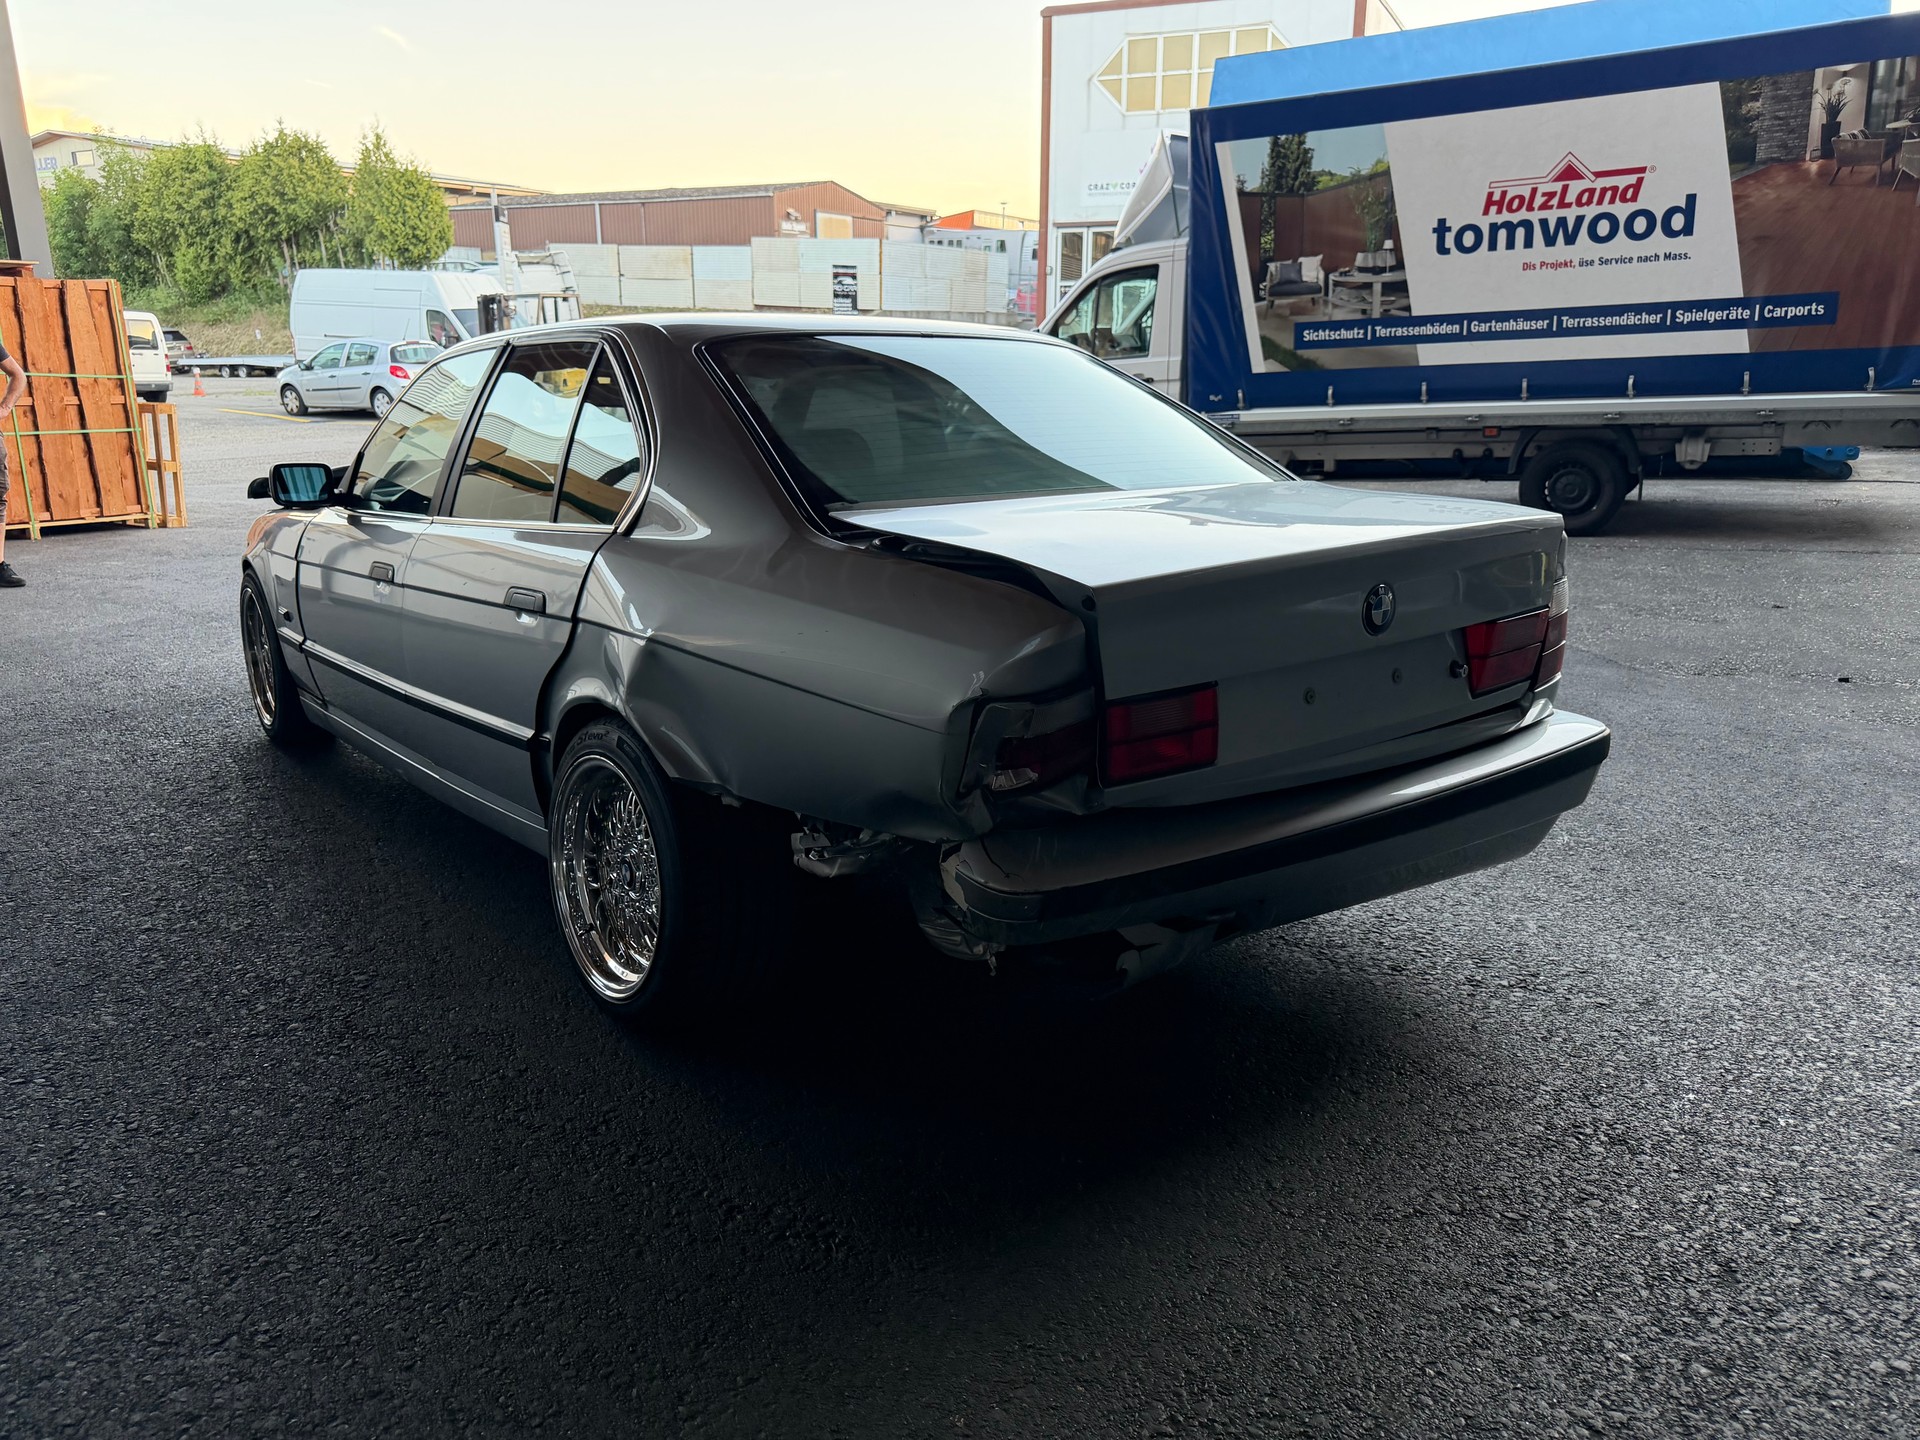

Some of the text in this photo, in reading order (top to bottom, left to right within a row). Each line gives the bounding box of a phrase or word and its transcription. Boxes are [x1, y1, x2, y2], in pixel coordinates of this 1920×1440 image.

[1481, 176, 1645, 216] HolzLand
[1432, 193, 1698, 256] tomwood
[1522, 251, 1692, 271] Dis Projekt, üse Service nach Mass.
[1303, 302, 1825, 342] Sichtschutz Terrassenböden Gartenhäuser Terrassendächer Spielgeräte Carports
